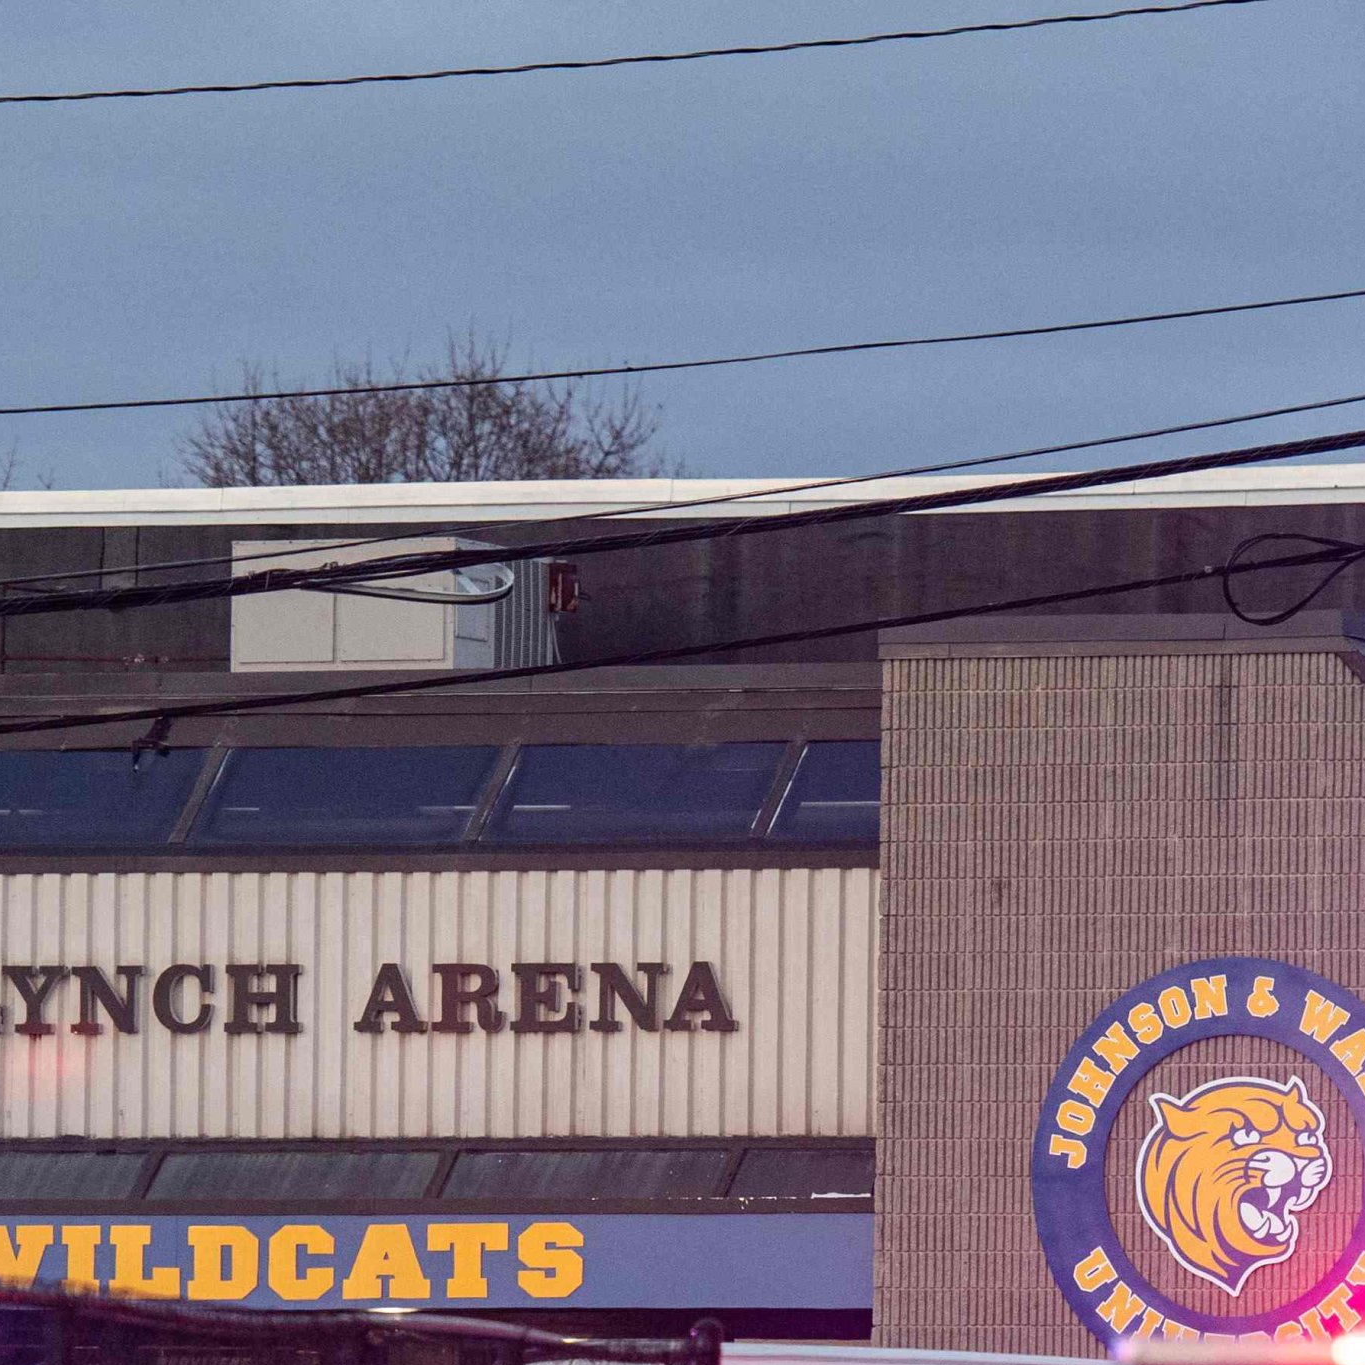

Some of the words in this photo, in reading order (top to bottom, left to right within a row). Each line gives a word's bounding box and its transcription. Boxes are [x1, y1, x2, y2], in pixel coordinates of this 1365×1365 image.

[353, 961, 740, 1034] ARENA
[1049, 975, 1228, 1169] JOHNSON
[1246, 976, 1280, 1018] &
